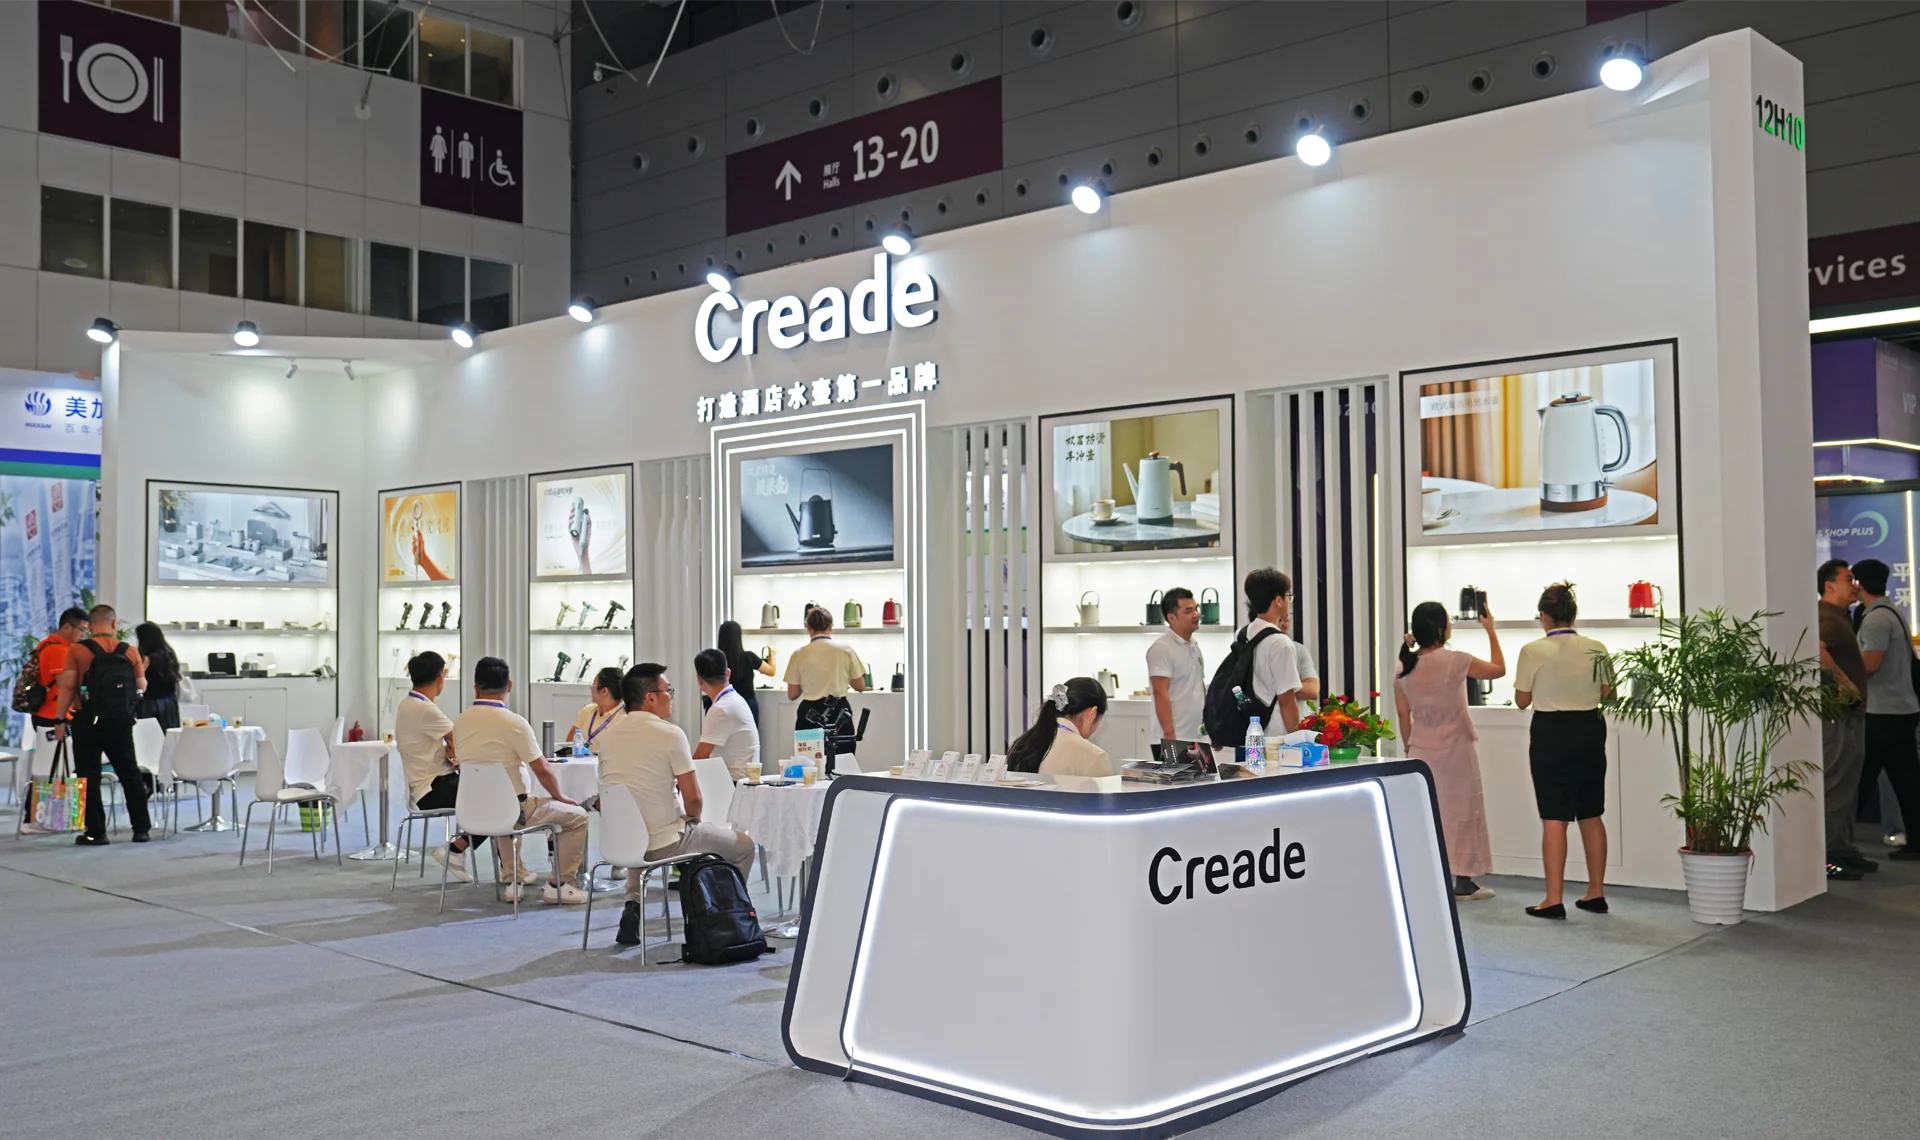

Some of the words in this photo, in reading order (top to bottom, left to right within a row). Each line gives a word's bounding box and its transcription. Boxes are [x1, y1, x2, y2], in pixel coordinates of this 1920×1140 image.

[853, 120, 939, 182] 13-20
[1755, 94, 1805, 151] 12H10
[823, 176, 840, 190] Halls
[1808, 254, 1906, 286] vices
[694, 251, 939, 363] Creade
[697, 361, 940, 423] 打造酒店水壶第一品牌
[1824, 528, 1850, 537] SHOP
[1851, 526, 1875, 536] PLUS
[1148, 827, 1306, 905] Creade
